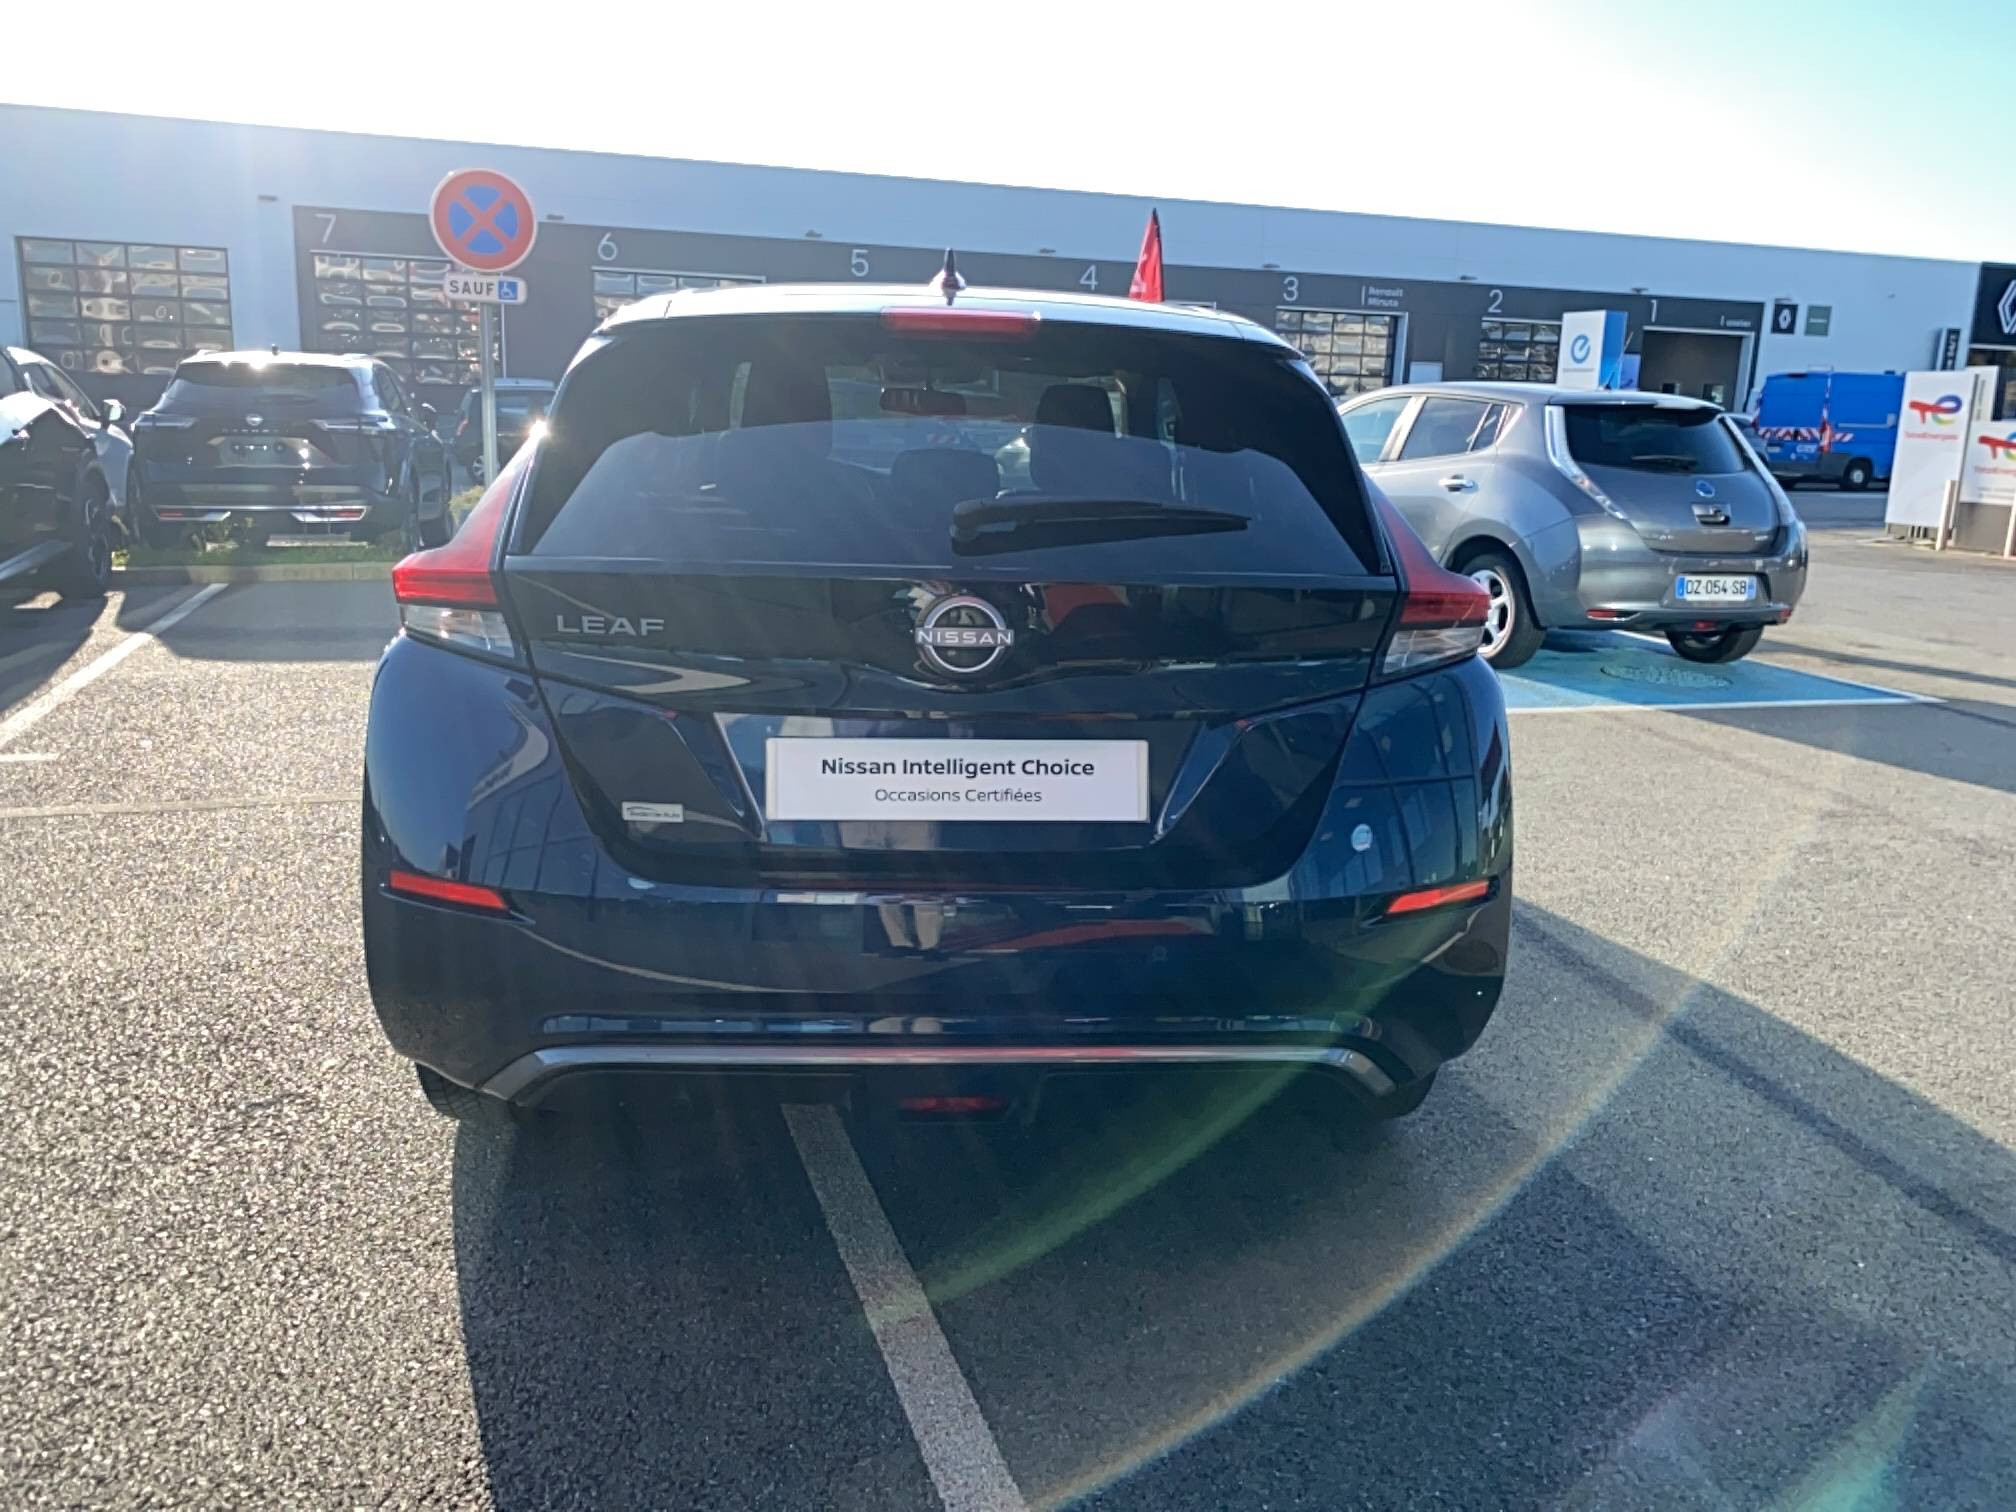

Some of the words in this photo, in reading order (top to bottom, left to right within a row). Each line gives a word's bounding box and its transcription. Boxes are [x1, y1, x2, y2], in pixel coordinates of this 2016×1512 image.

[315, 213, 337, 243] 7
[598, 231, 617, 261] 6
[851, 249, 869, 277] 5
[449, 280, 495, 296] SAUF
[1080, 264, 1098, 290] 4
[1283, 276, 1299, 301] 3
[1488, 289, 1503, 313] 2
[1651, 299, 1658, 322] 1
[1686, 580, 1702, 594] DZ
[1705, 580, 1727, 594] 054
[1732, 581, 1747, 594] SB
[556, 615, 665, 636] LEAF
[918, 631, 1012, 644] NISSAN
[821, 758, 896, 775] Nissan
[902, 758, 1016, 779] Intelligent
[1021, 759, 1095, 776] Choice
[875, 788, 961, 802] Occasions
[965, 788, 1042, 802] Certifiées
